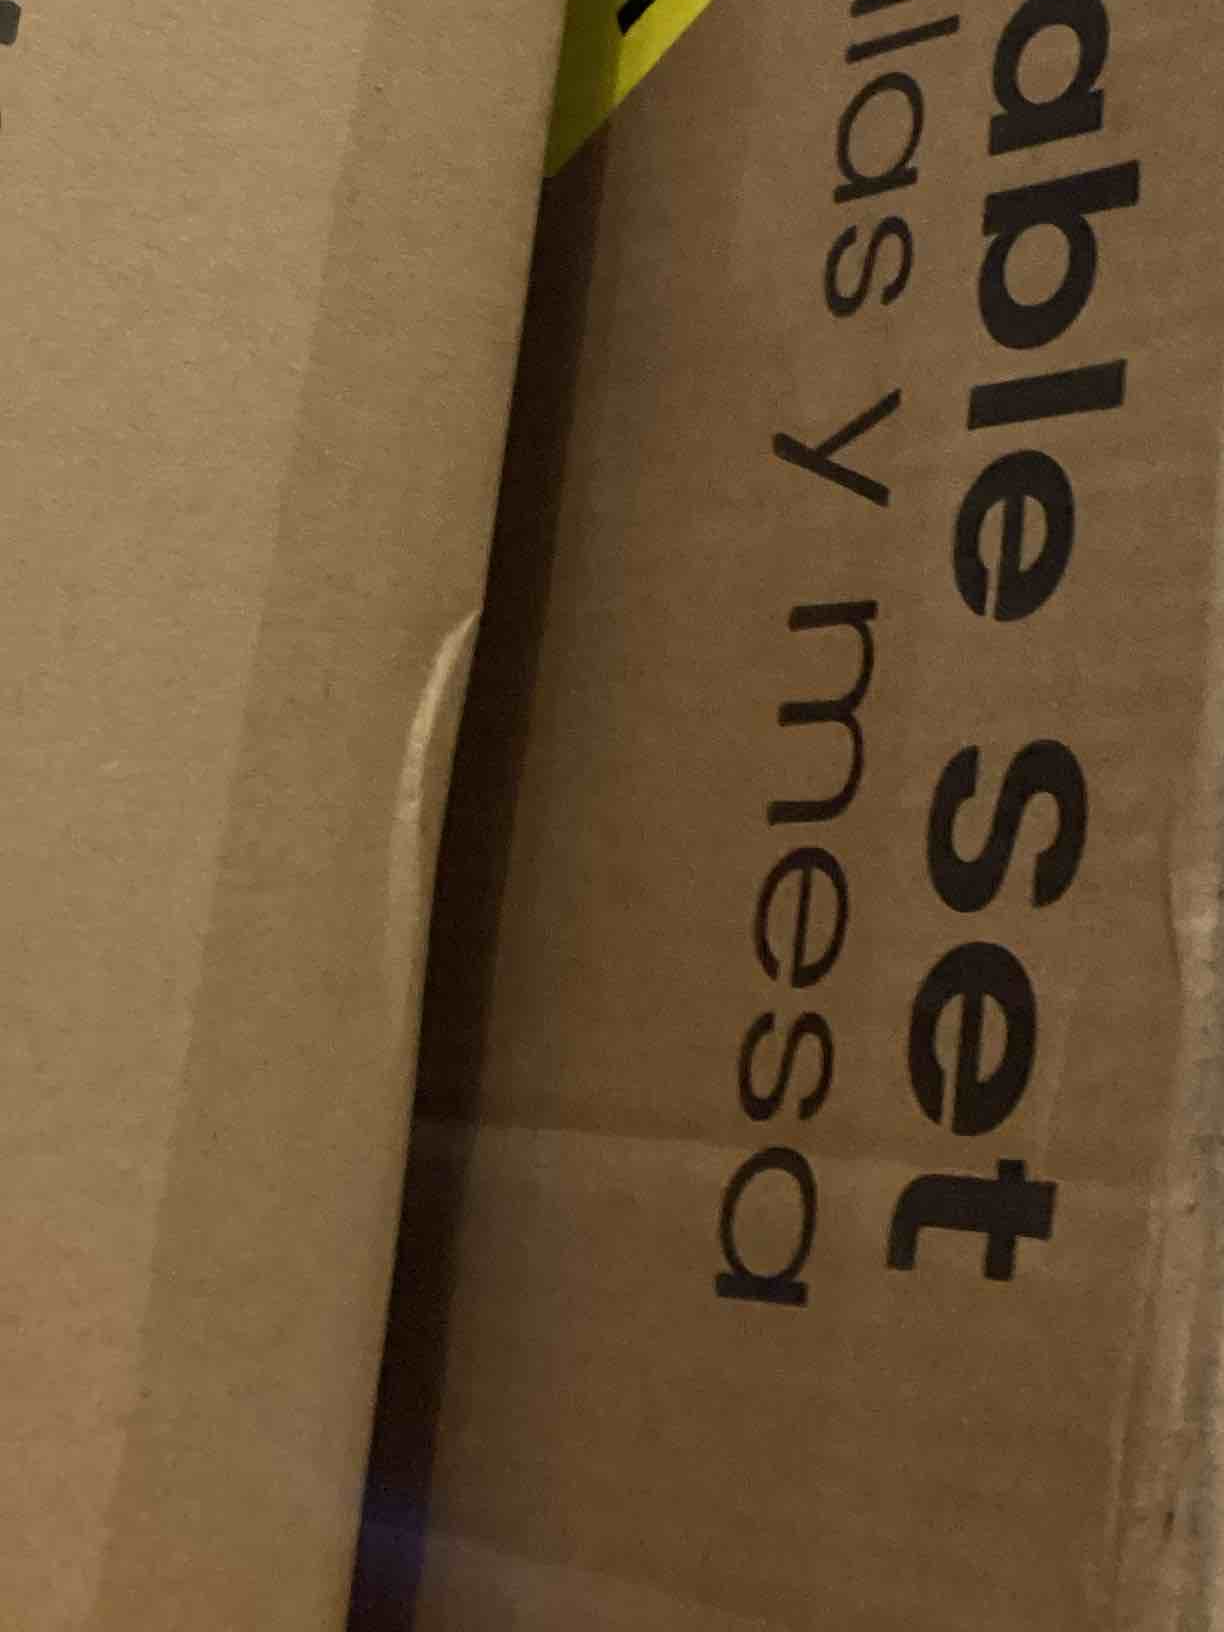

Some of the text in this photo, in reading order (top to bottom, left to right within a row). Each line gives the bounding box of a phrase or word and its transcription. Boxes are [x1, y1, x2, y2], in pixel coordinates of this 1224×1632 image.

[772, 387, 902, 507] y
[714, 599, 879, 1308] mesa
[885, 739, 1089, 1282] Set
